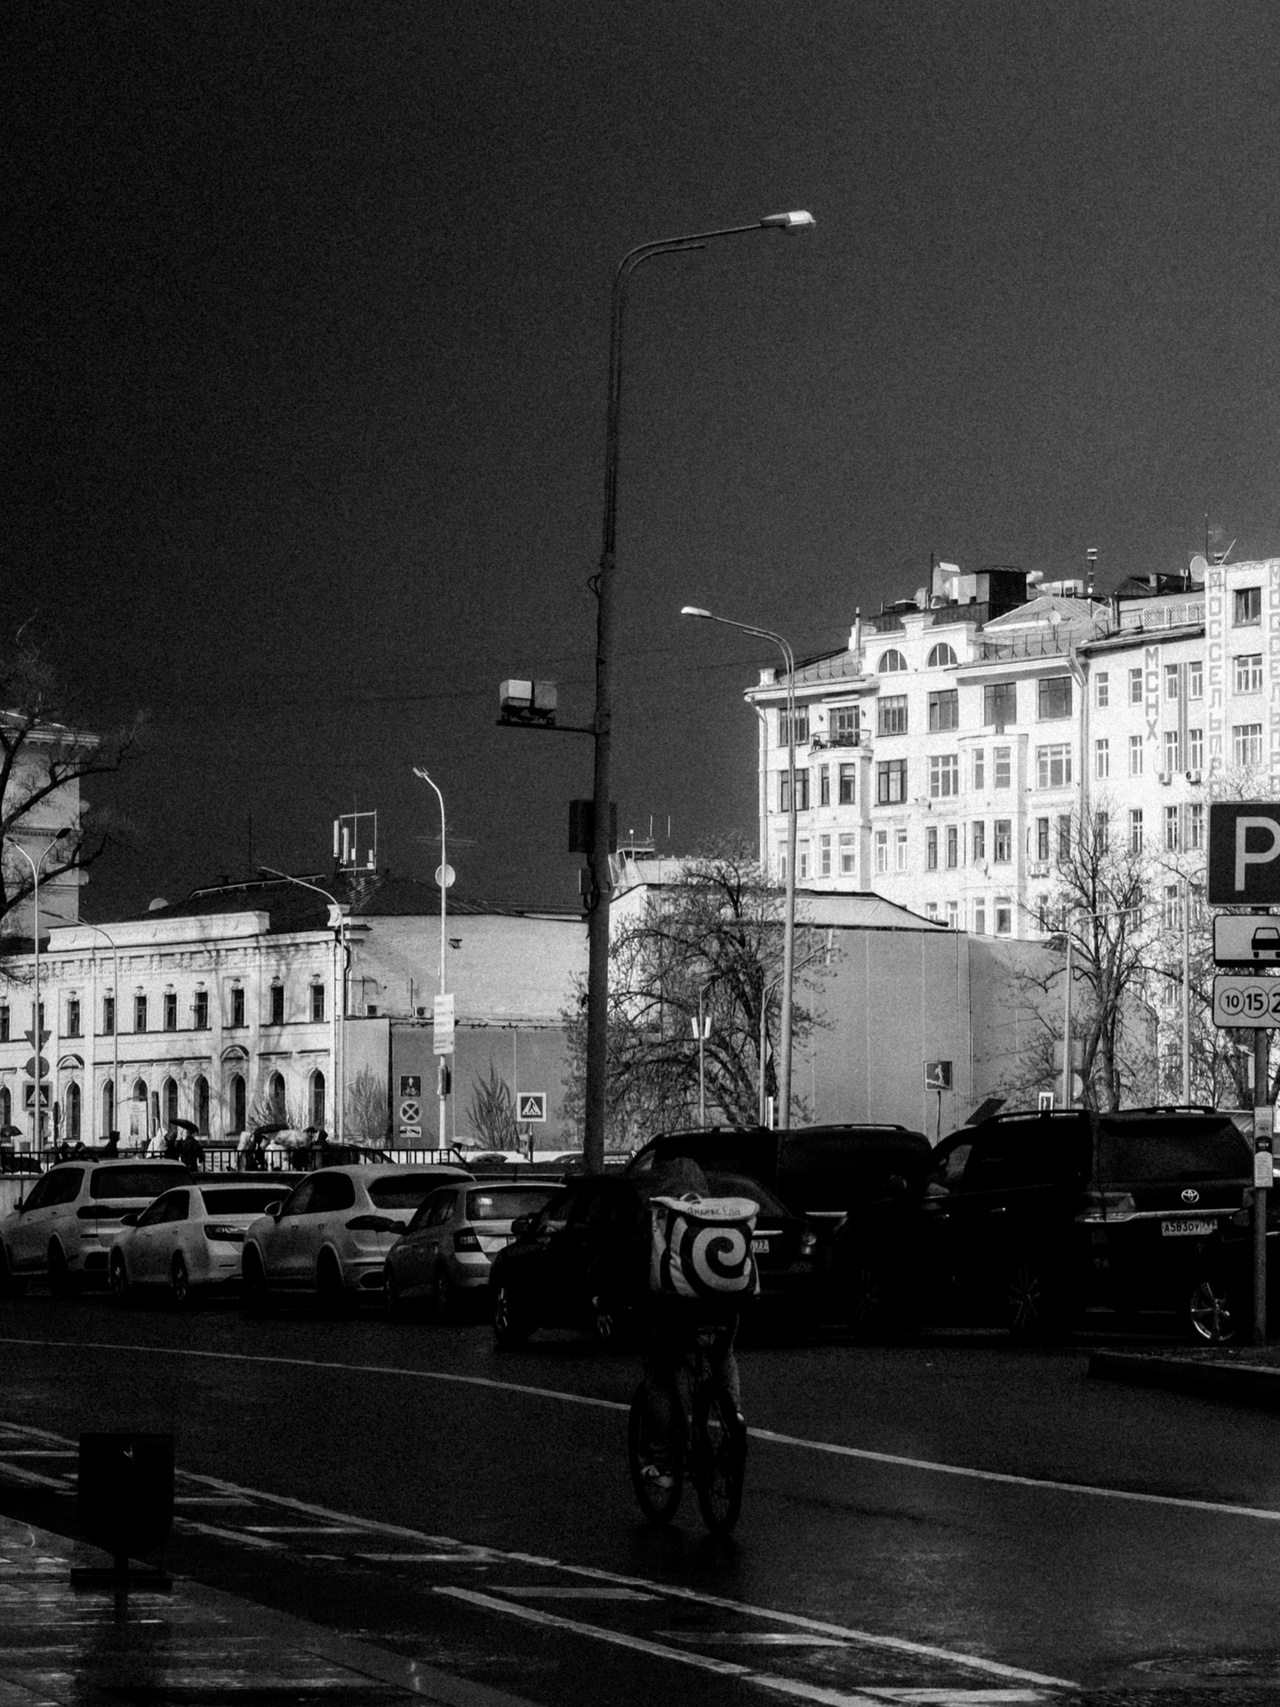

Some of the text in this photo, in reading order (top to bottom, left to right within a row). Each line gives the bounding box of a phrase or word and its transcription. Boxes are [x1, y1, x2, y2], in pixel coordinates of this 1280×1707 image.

[1144, 646, 1159, 742] МСНХ
[1209, 572, 1222, 799] МОССЕЛЬПРО
[1225, 995, 1240, 1008] 10
[1245, 993, 1264, 1011] 15
